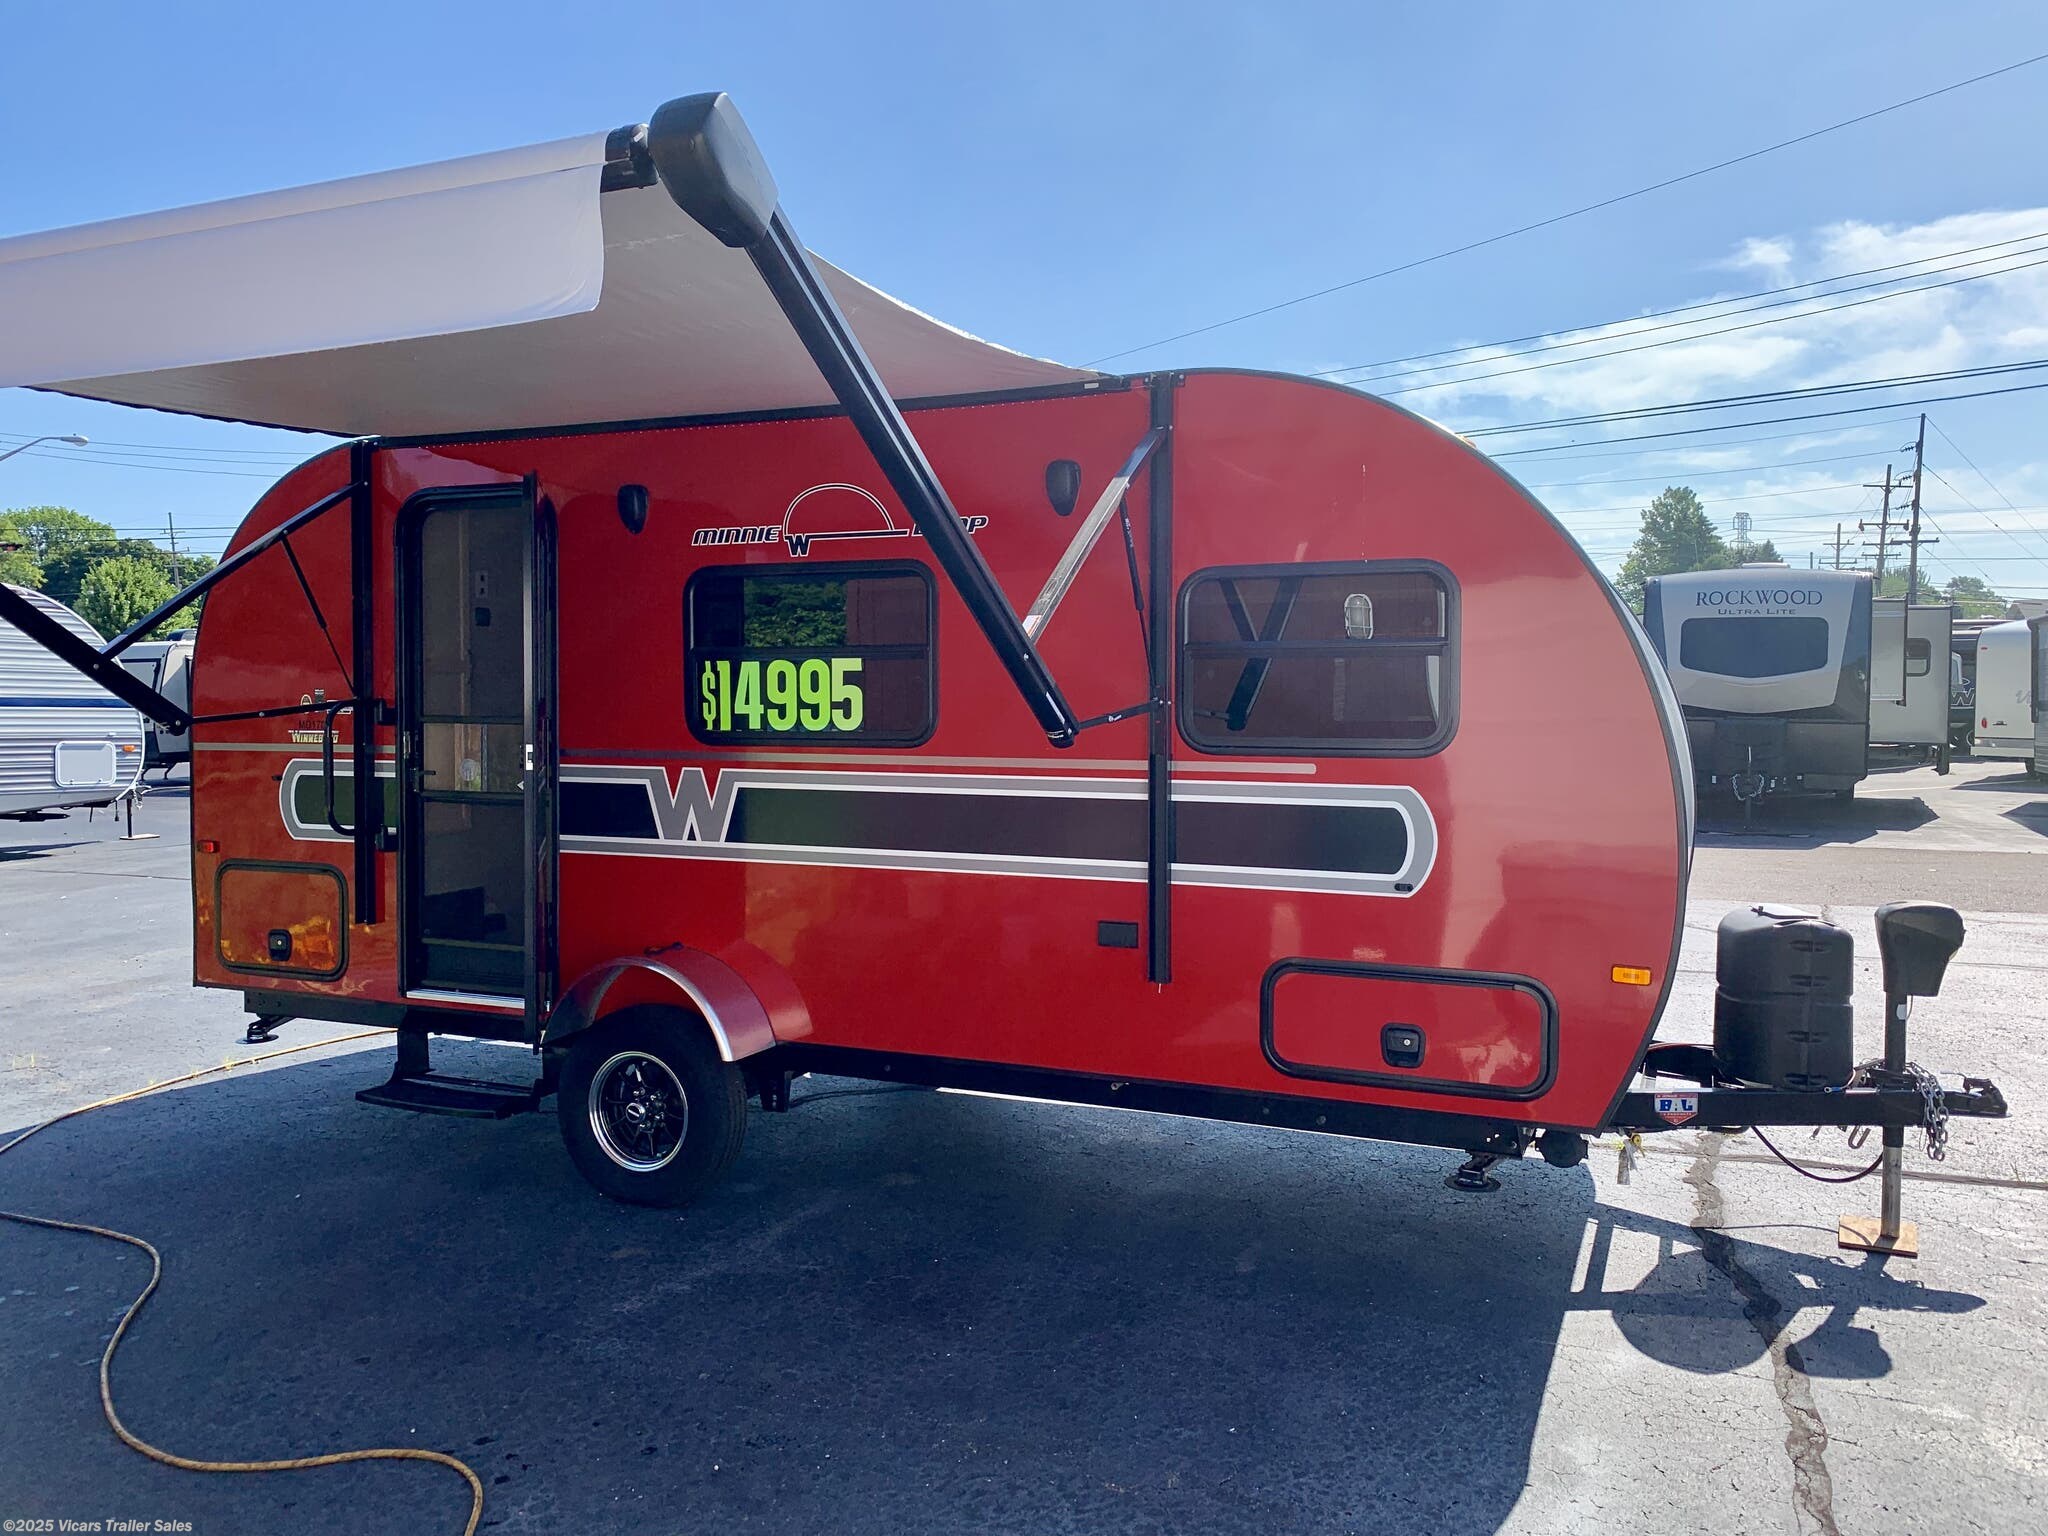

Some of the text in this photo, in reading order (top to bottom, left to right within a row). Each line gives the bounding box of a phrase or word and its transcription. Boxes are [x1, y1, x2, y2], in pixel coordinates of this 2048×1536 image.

[691, 525, 782, 546] MINNIE
[1696, 590, 1823, 606] ROCKWOOD
[702, 658, 864, 731] $14995
